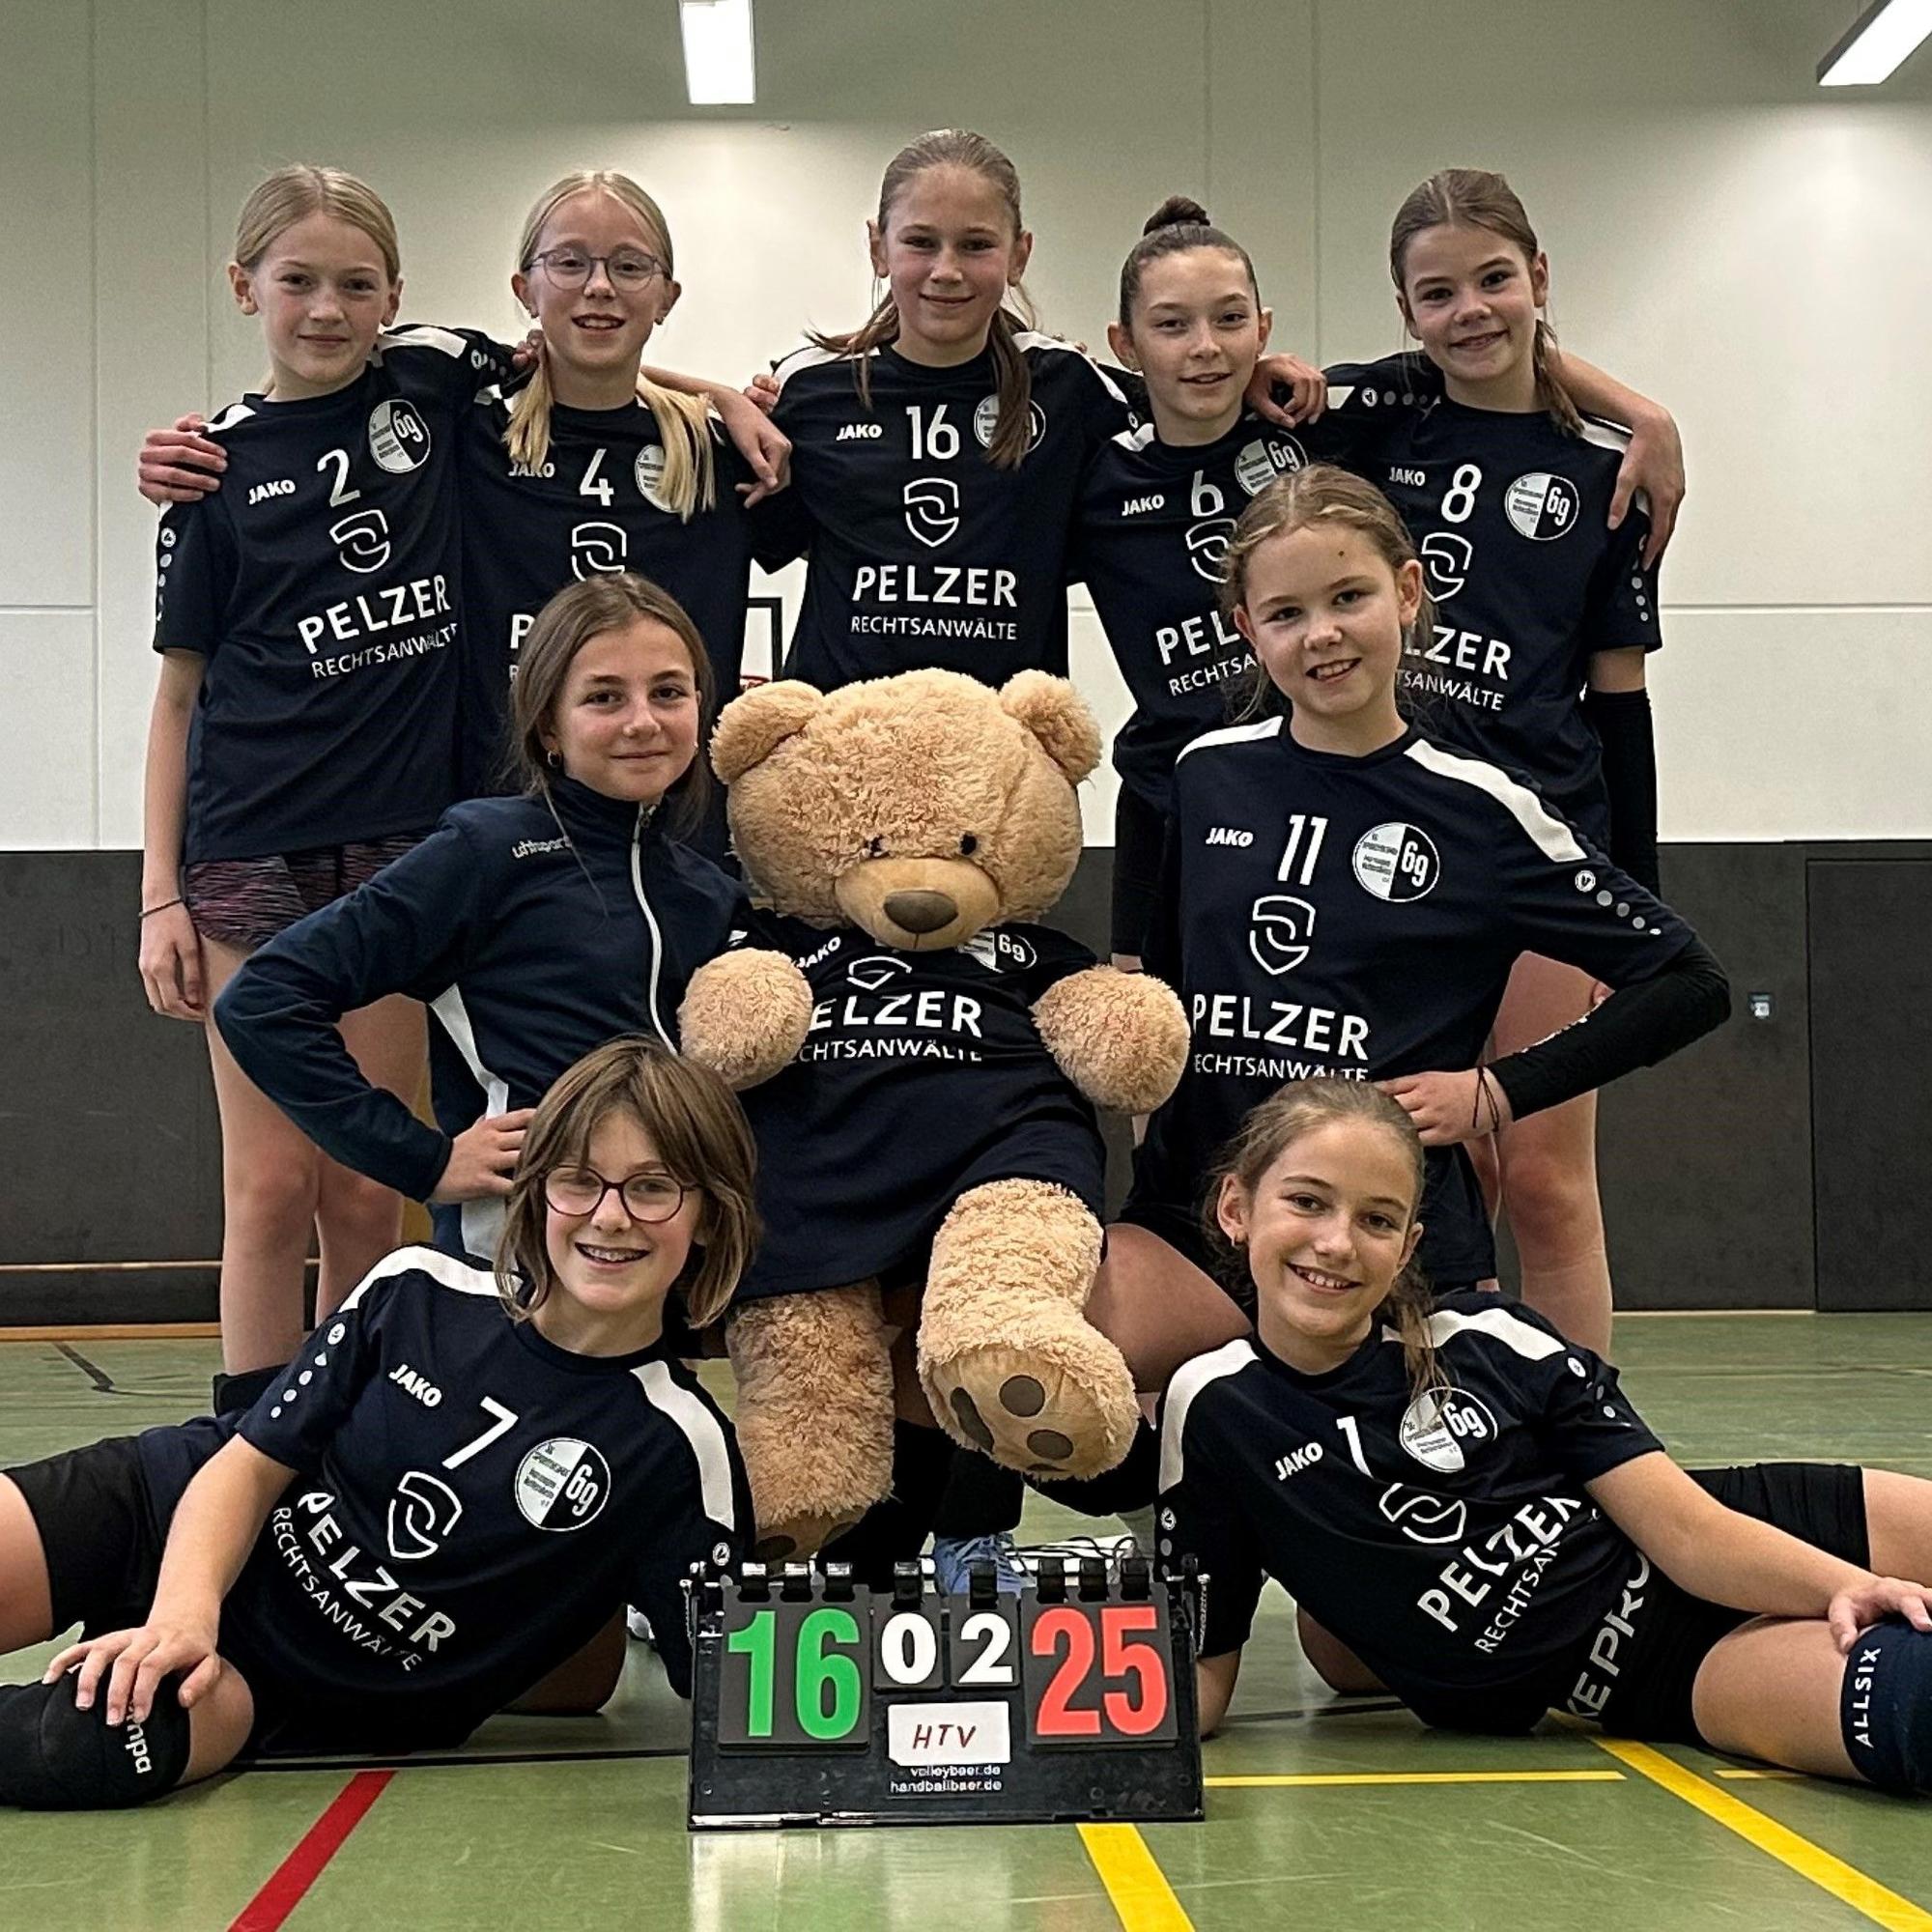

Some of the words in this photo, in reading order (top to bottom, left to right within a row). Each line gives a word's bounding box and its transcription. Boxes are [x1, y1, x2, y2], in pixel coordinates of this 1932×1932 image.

[836, 424, 883, 441] JAKO
[906, 405, 960, 461] 16
[248, 479, 296, 505] JAKO
[317, 448, 361, 507] 2
[580, 448, 614, 506] 4
[1190, 469, 1224, 517] 6
[1389, 467, 1426, 487] JAKO
[1440, 464, 1482, 524] 8
[1122, 495, 1165, 517] JAKO
[852, 564, 1018, 608] PELZER
[298, 575, 451, 655] PELZER
[850, 615, 1018, 641] RECHTSANWÄLTE
[1156, 610, 1240, 666] PEL
[1169, 653, 1259, 696] RECHTSA
[1404, 624, 1512, 681] LZER
[1206, 827, 1254, 848] JAKO
[1277, 814, 1329, 886] 11
[795, 936, 841, 968] JAKO
[809, 990, 983, 1039] ELZER
[1193, 993, 1370, 1062] PELZER
[387, 1364, 443, 1407] JAKO
[441, 1396, 520, 1470] 7
[1336, 1415, 1374, 1479] 1
[1274, 1441, 1324, 1481] JAKO
[298, 1491, 457, 1653] PELZER
[727, 1608, 863, 1740] 16
[1031, 1606, 1169, 1737] 25
[1567, 1670, 1612, 1718] KE
[1852, 1647, 1882, 1749] ALLSIX
[912, 1723, 978, 1749] HTV
